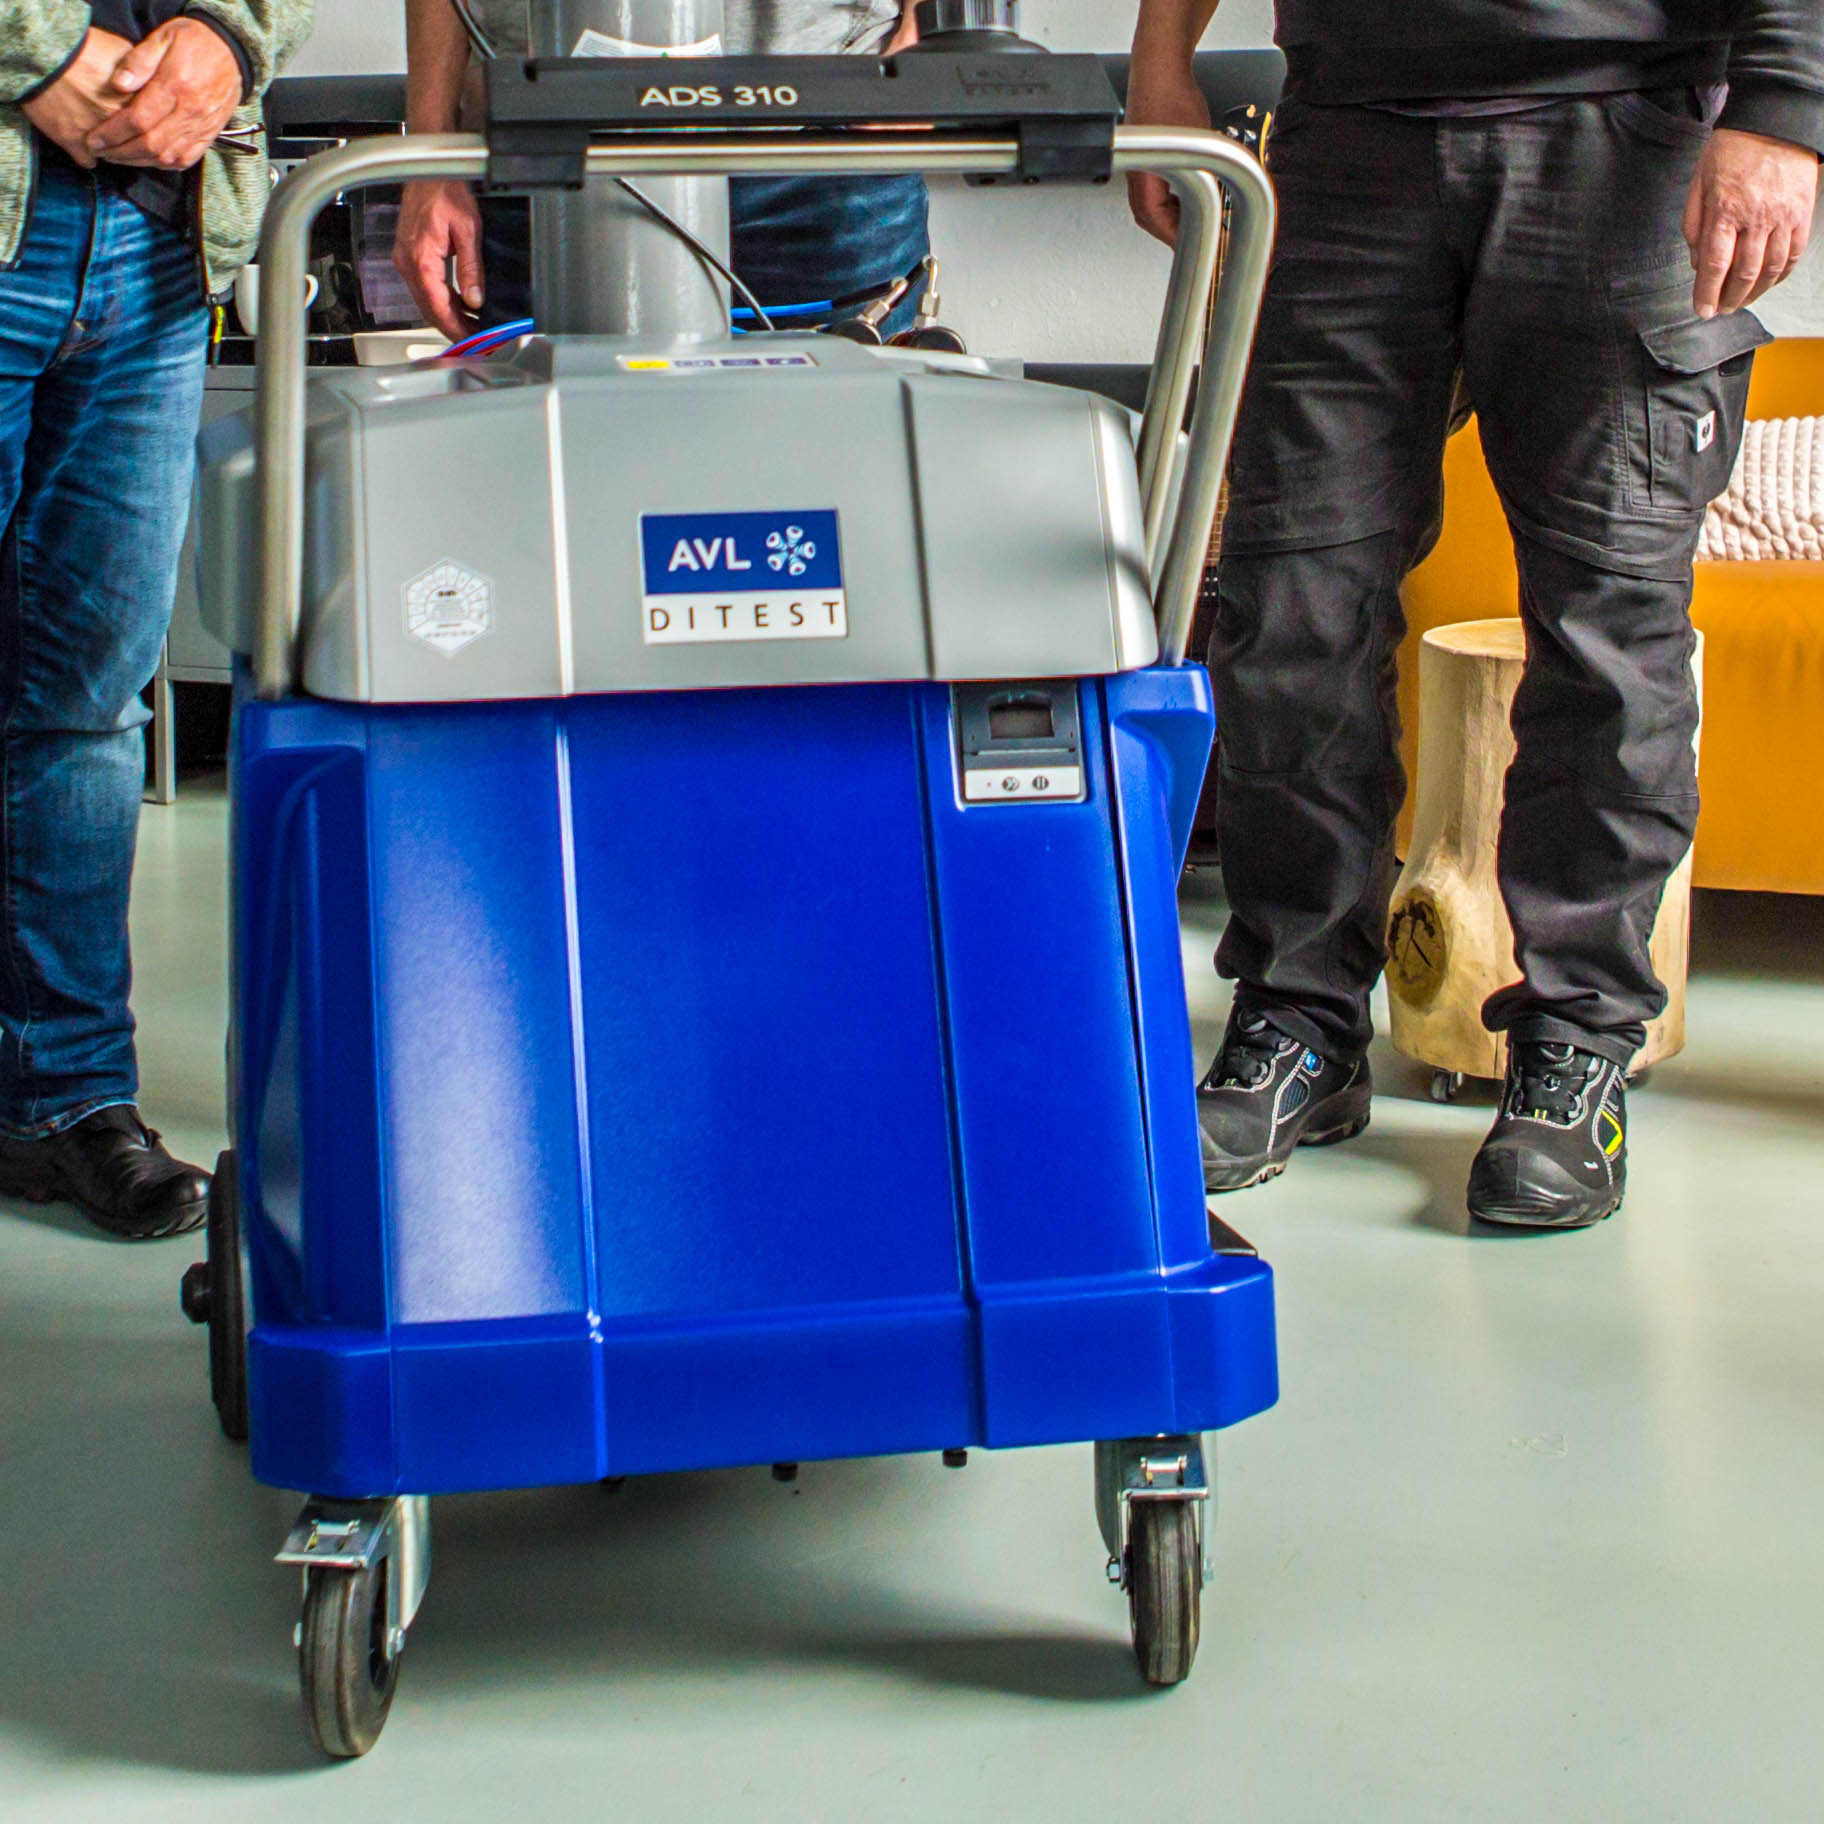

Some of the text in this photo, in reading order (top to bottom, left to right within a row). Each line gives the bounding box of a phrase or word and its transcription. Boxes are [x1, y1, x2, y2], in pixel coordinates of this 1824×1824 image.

[640, 86, 799, 107] ADS 310
[668, 537, 752, 572] AVL
[649, 601, 840, 632] DITEST
